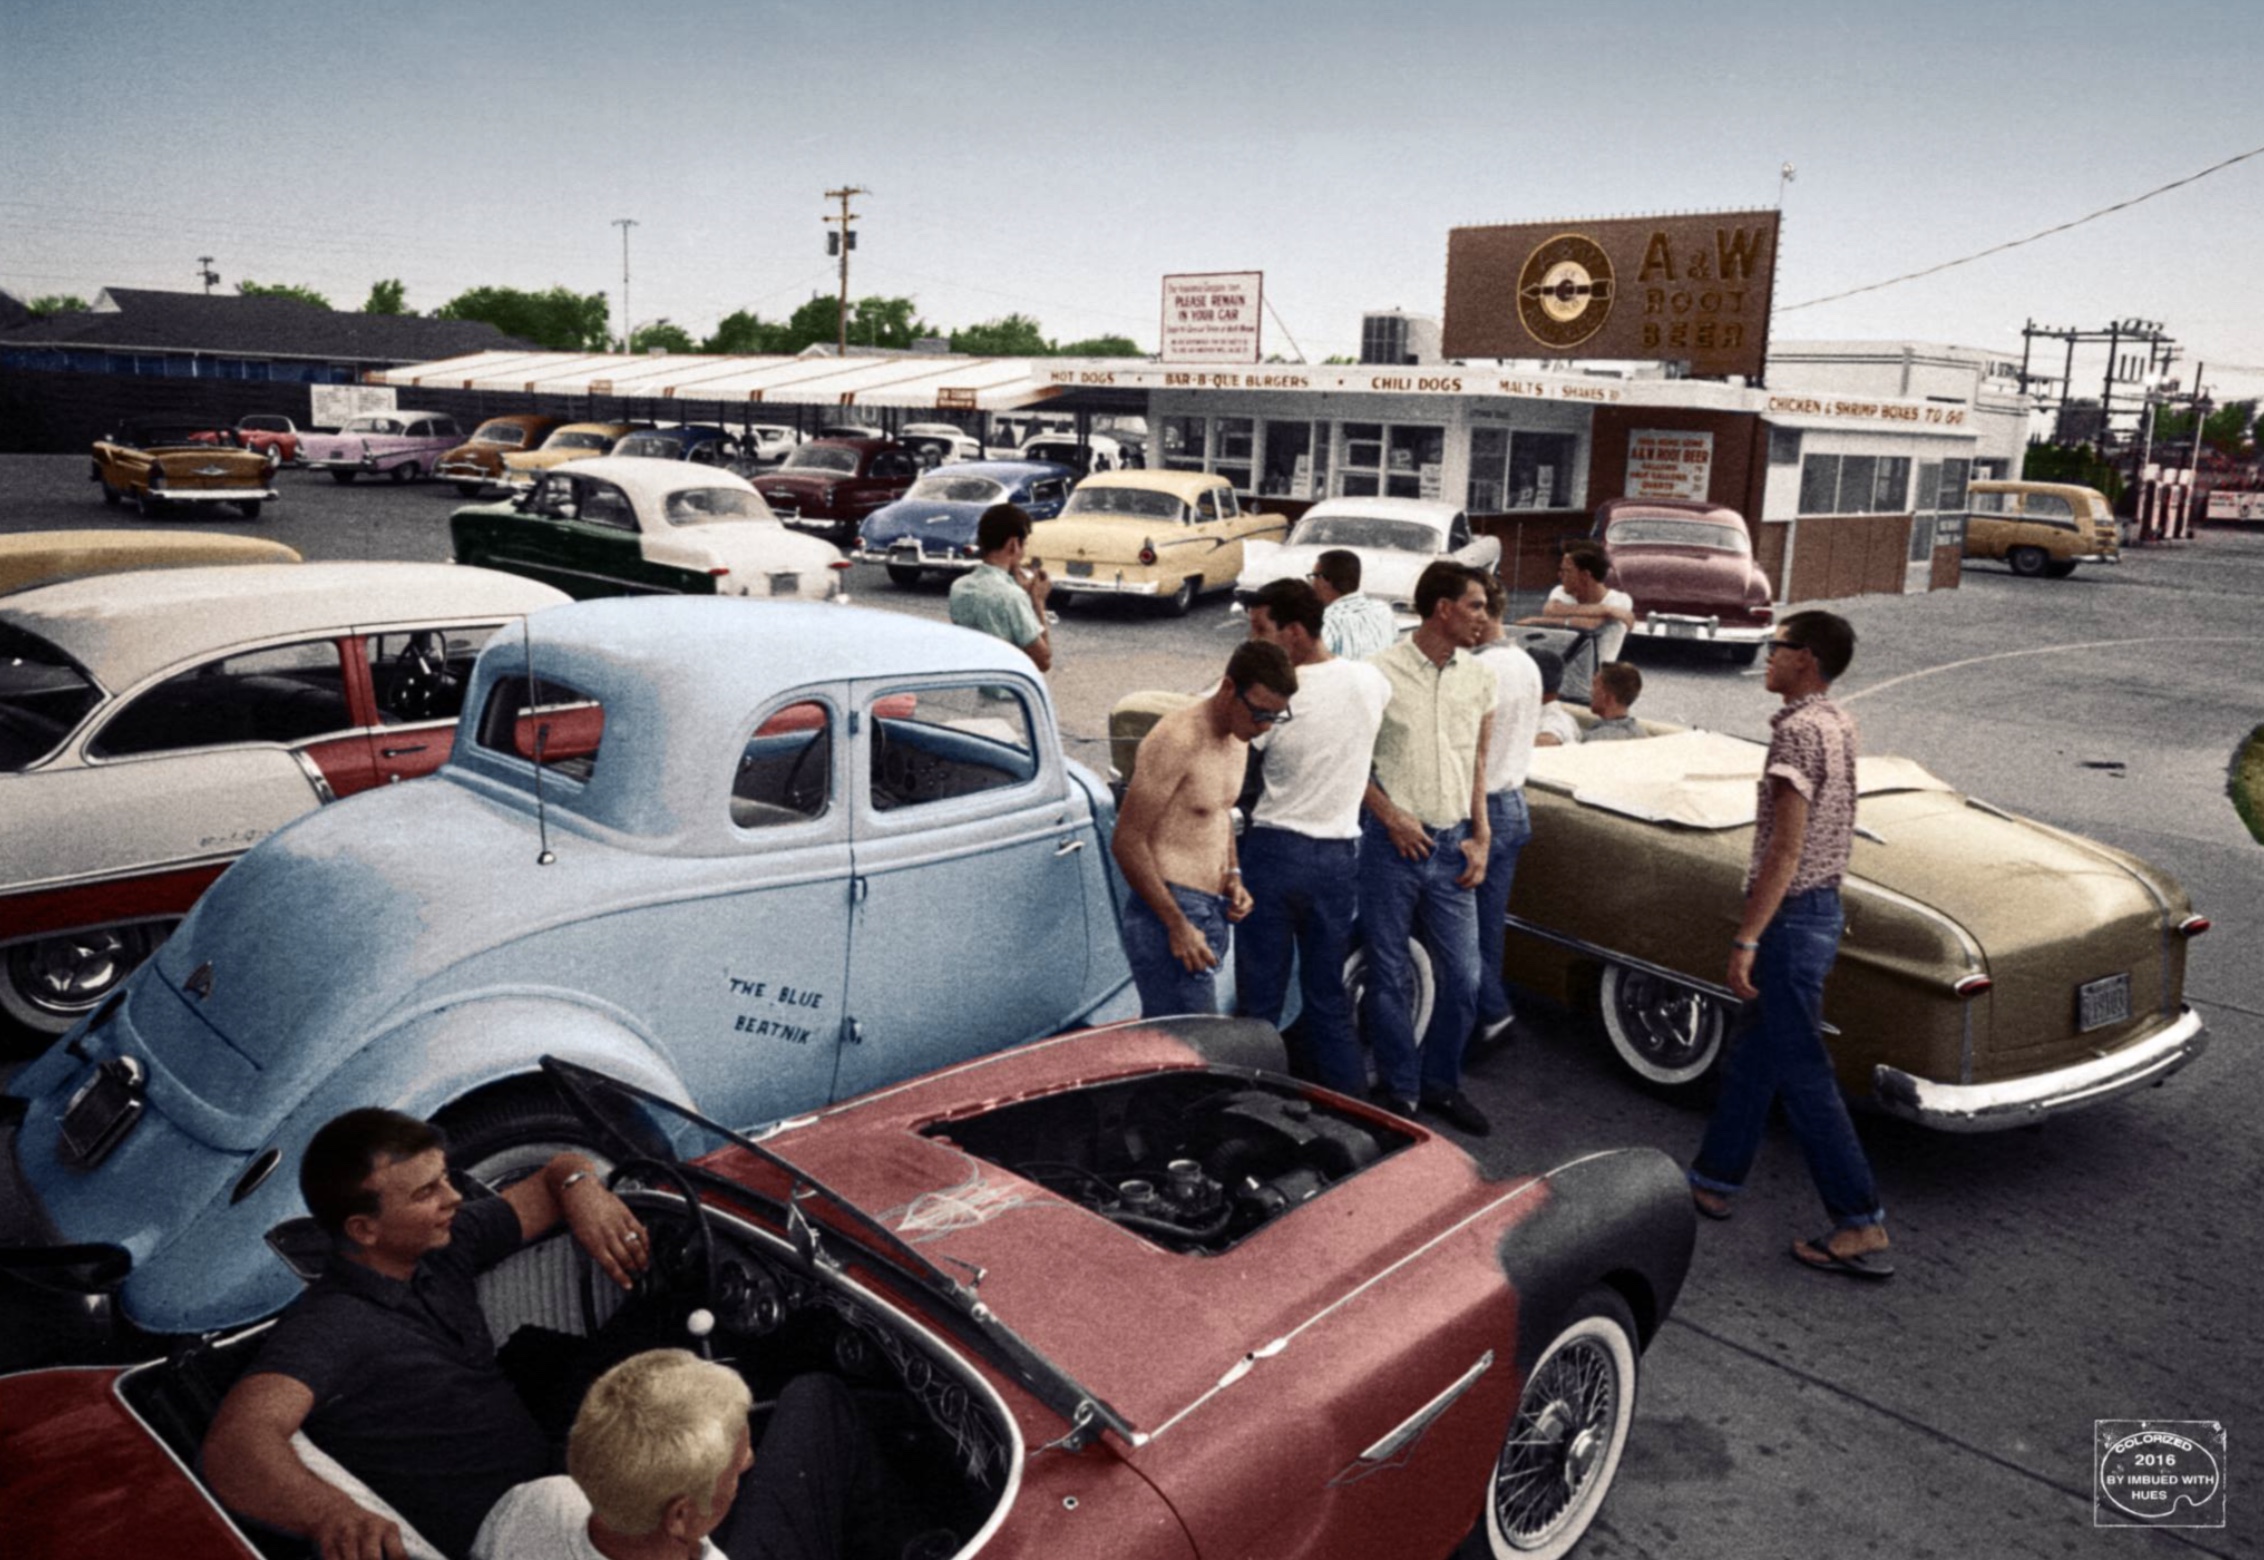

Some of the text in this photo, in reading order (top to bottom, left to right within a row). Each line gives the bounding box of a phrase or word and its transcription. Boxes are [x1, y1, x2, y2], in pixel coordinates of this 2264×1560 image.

[1175, 294, 1246, 308] PLEASE REMAIN
[1645, 289, 1746, 315] ROOT
[1178, 308, 1239, 321] IN YOUR CAR
[1642, 320, 1744, 349] BEER
[1050, 371, 1116, 385] HOT DOGS
[1245, 374, 1310, 389] BURGERS
[1371, 376, 1463, 392] CHILI DOGS
[1499, 379, 1544, 397] MALTS
[1561, 385, 1605, 401] SHAKES
[1768, 397, 1822, 414] CHICKEN
[1835, 401, 1879, 417] SHRIMP
[1881, 405, 1919, 421] BOXES
[1924, 407, 1943, 423] TO
[1945, 410, 1965, 425] GO
[1656, 448, 1682, 461] ROOT
[1683, 449, 1709, 464] BEER
[730, 977, 824, 1009] THE BLUE
[734, 1014, 812, 1045] BEATNIK
